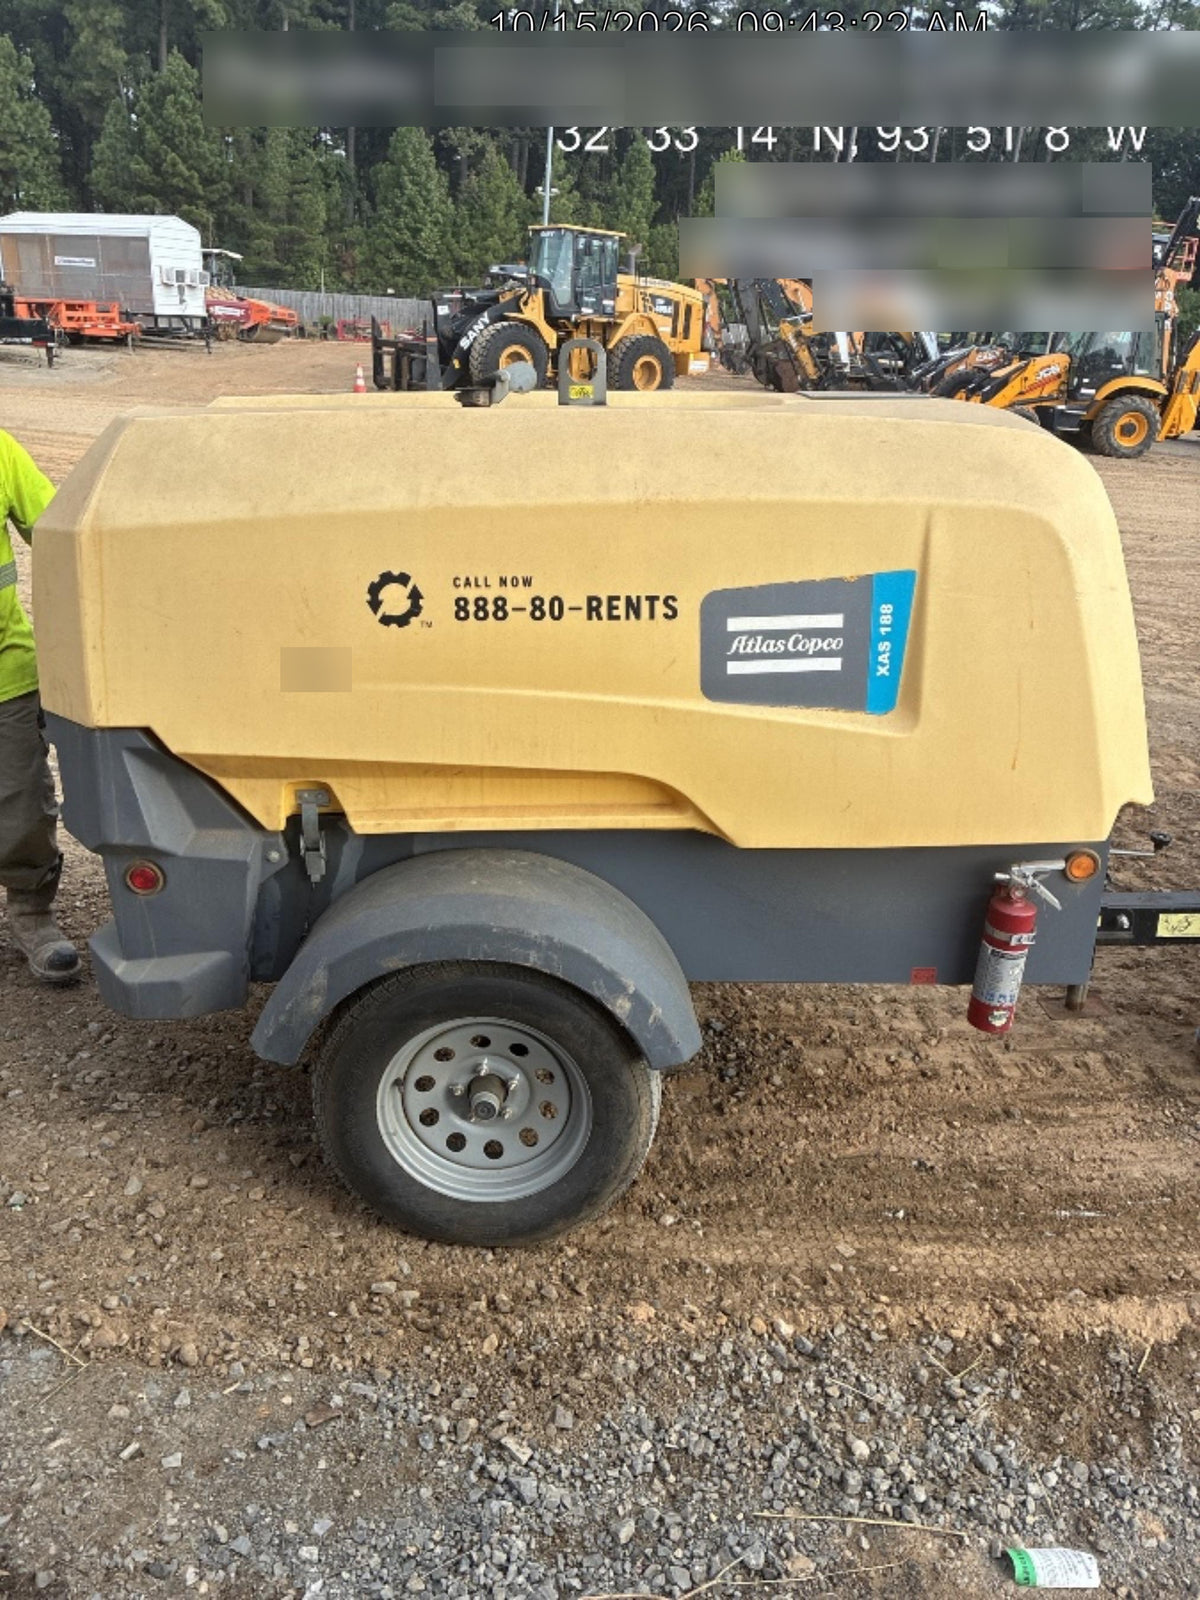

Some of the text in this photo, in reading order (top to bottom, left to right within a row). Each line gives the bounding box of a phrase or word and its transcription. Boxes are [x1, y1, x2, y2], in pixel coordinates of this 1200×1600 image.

[459, 311, 490, 350] SANY
[453, 575, 533, 588] CALL NOW
[454, 595, 679, 621] 888-80-RENTS
[726, 633, 844, 655] Atlas Copco
[876, 603, 893, 677] XAS 188
